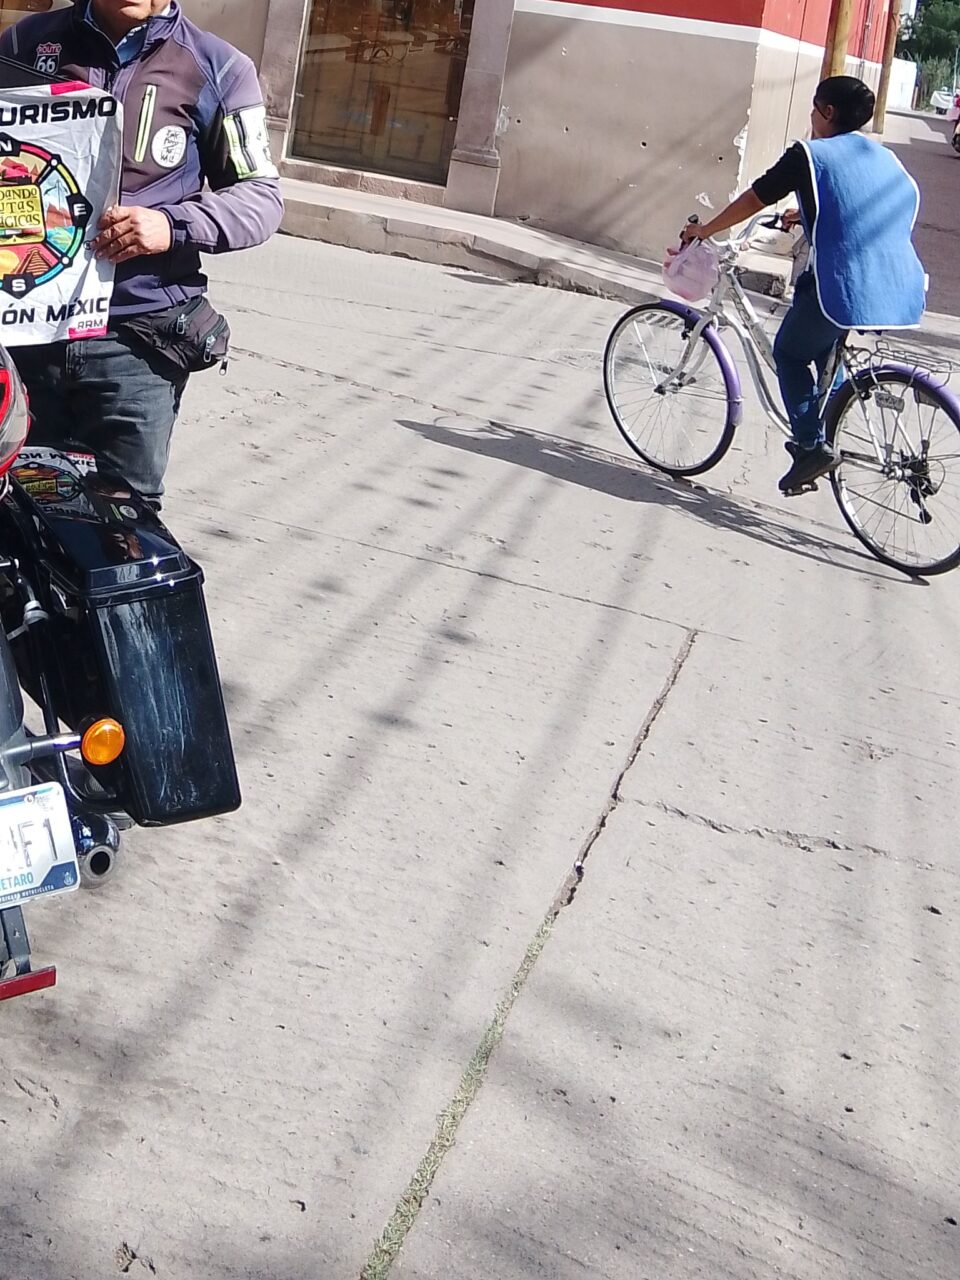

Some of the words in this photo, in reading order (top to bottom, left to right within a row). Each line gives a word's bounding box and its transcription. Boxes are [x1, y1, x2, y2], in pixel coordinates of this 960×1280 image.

[37, 56, 56, 72] 66
[74, 202, 87, 216] E
[11, 279, 26, 291] S
